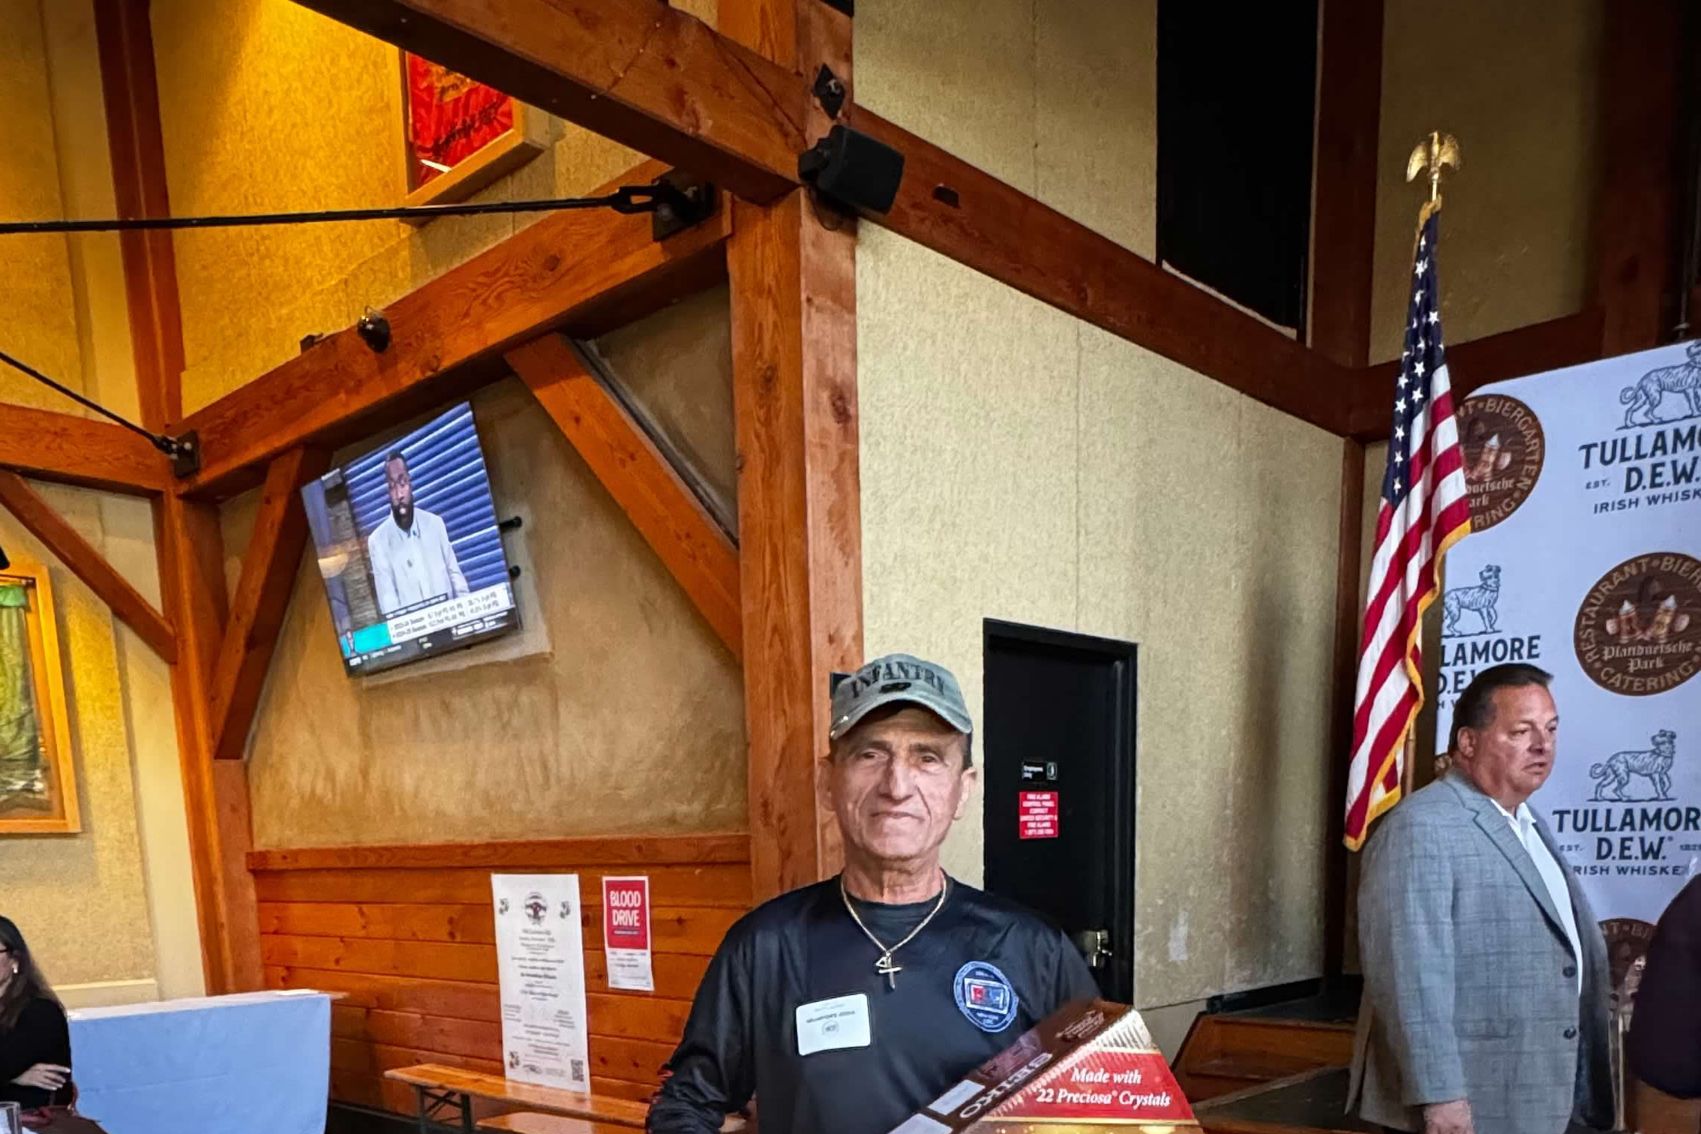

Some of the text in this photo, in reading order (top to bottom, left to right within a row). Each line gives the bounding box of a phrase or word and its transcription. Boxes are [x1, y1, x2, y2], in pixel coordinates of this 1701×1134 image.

[1485, 398, 1541, 491] BIERGARTEN
[1578, 424, 1701, 470] TULLAM
[1585, 478, 1611, 490] EST.
[1624, 455, 1700, 494] D.E.W.
[1473, 497, 1517, 530] RING
[1593, 488, 1701, 515] IRISH WHISK
[1580, 557, 1650, 663] RESTAURANT
[1440, 634, 1542, 668] LAMORE
[1628, 656, 1665, 673] Park
[851, 660, 946, 699] INFANTRY
[1600, 660, 1694, 692] CATERING
[1551, 806, 1701, 833] TULLAMOR
[1596, 835, 1667, 861] D.E.W.
[1572, 865, 1610, 876] RISH
[609, 889, 642, 909] BLOOD
[611, 908, 642, 928] DRIVE
[1070, 1066, 1142, 1085] Made with
[1036, 1087, 1055, 1104] 22
[1118, 1089, 1171, 1110] Crystals
